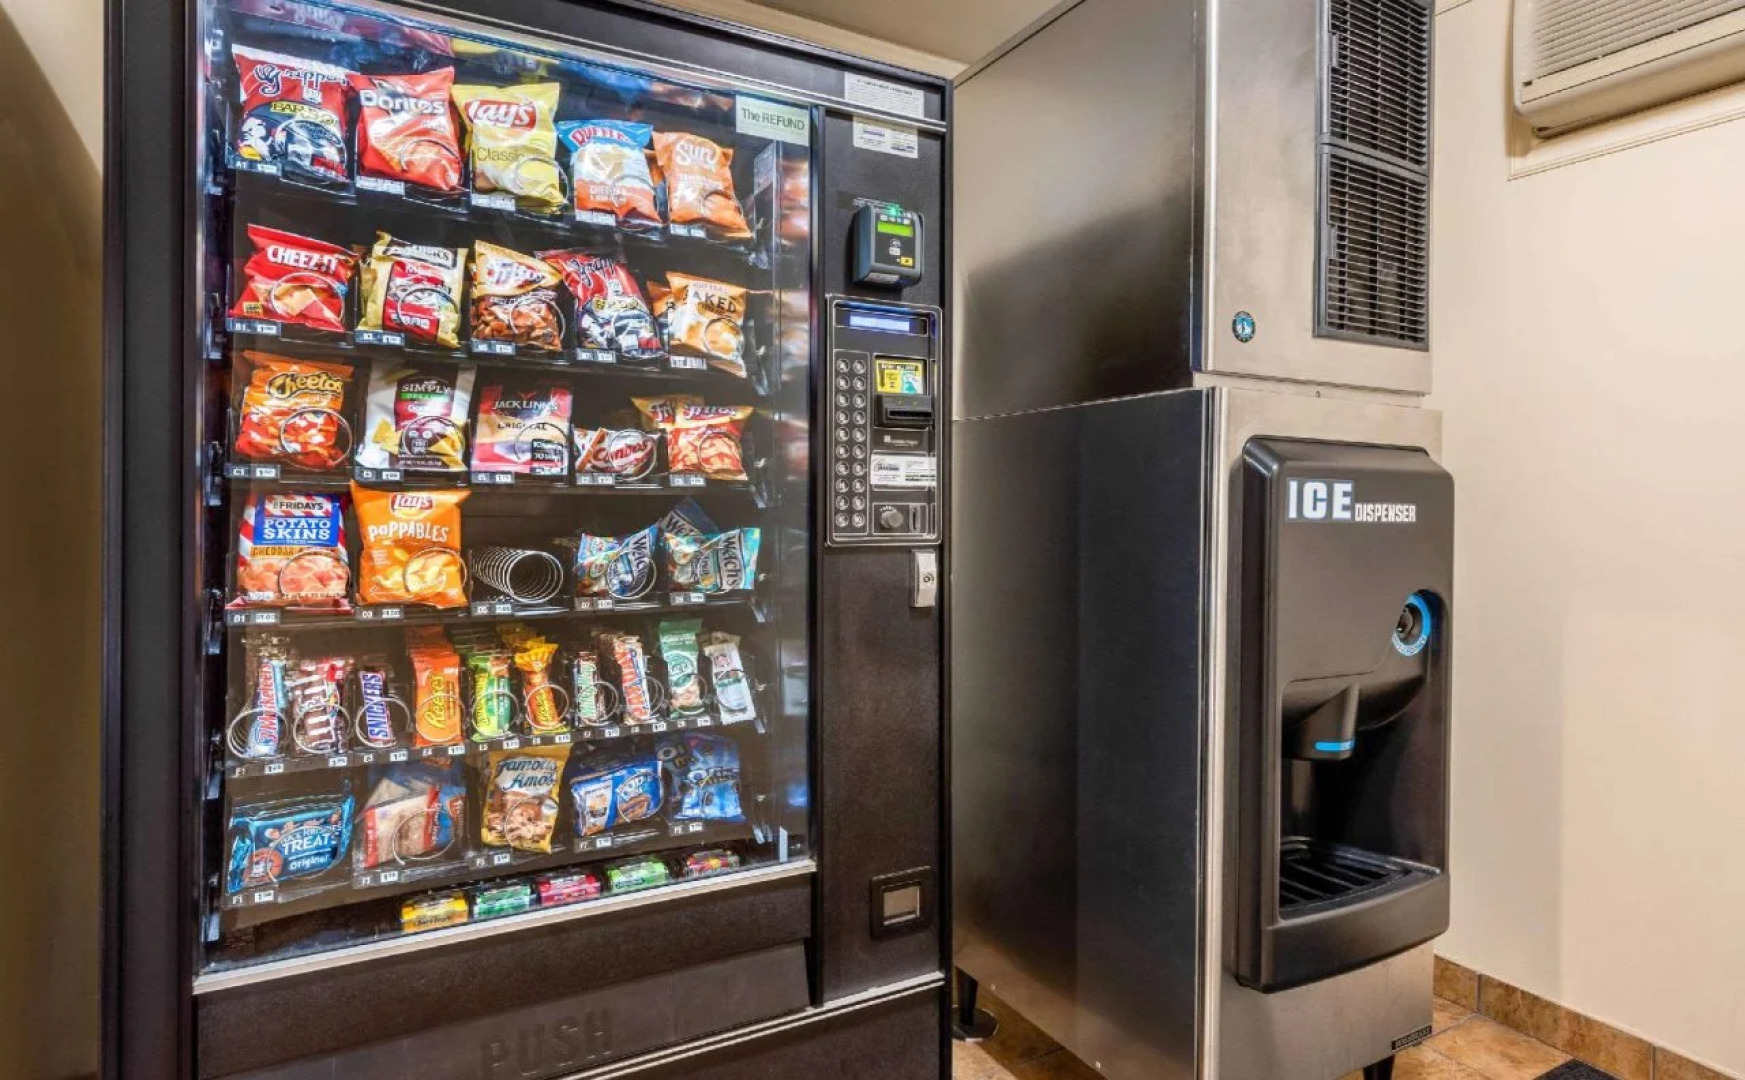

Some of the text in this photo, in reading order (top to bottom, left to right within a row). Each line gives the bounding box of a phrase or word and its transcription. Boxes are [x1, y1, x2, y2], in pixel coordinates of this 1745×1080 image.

[360, 89, 446, 114] Doritos
[741, 108, 805, 131] The REFUND
[476, 147, 526, 163] Classic
[691, 288, 737, 314] AKED
[267, 371, 344, 399] Cheetos
[401, 382, 451, 394] SIMPLY
[492, 400, 521, 410] JACK
[498, 422, 547, 431] ORIGAL
[279, 501, 324, 511] FRIDAY'S
[1288, 479, 1417, 522] ICE DISPENSER
[264, 518, 331, 529] POTATO
[263, 529, 331, 540] SKINS
[253, 547, 294, 556] CHEDDAR
[362, 673, 390, 739] SNICKERS
[498, 758, 557, 775] Famous
[503, 773, 556, 790] Amos
[481, 1008, 613, 1080] PUSH
